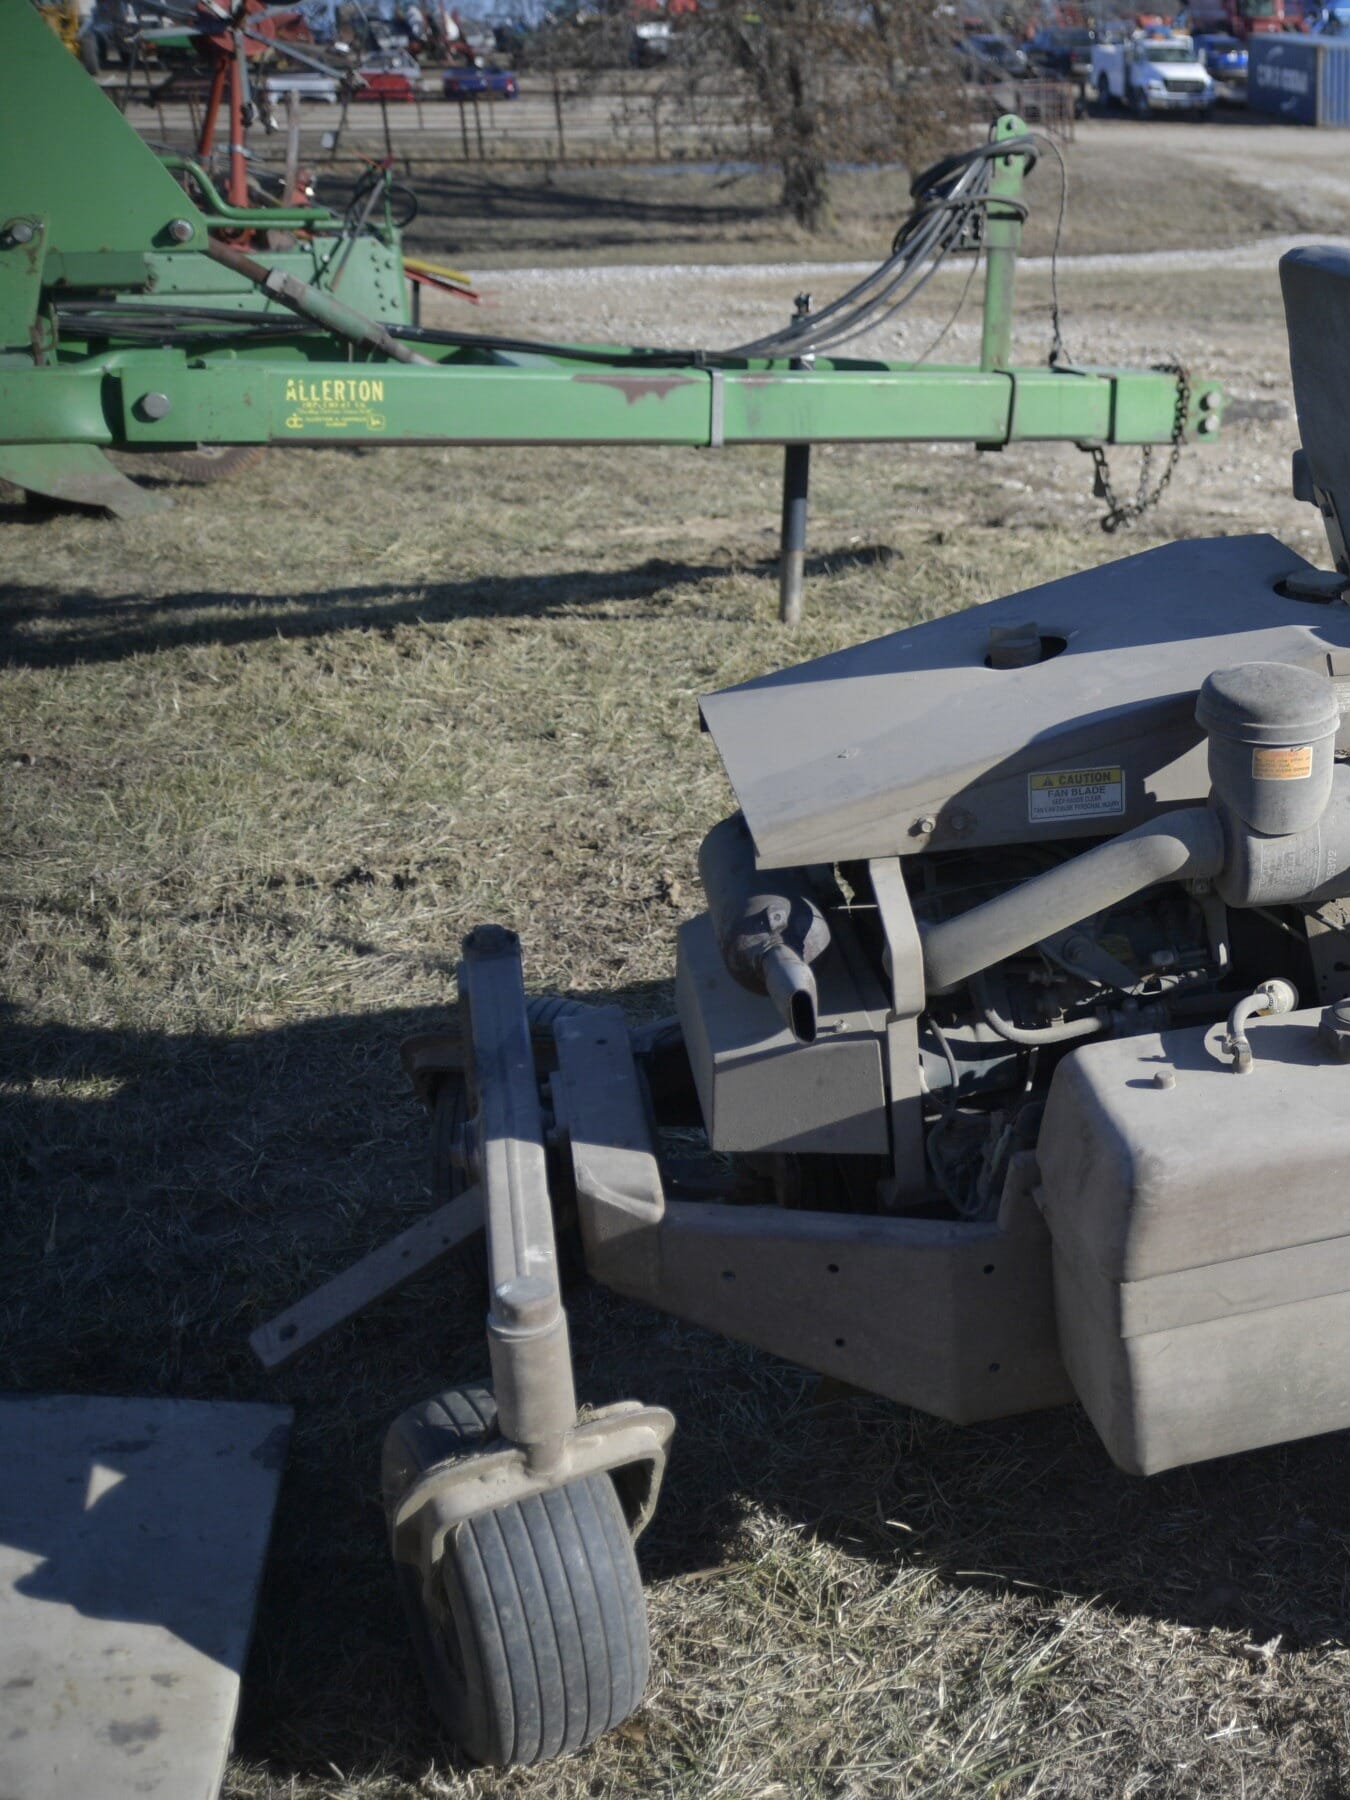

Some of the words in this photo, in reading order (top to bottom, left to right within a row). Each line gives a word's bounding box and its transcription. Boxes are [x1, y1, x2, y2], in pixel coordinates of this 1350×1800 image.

[285, 379, 384, 402] ALLERTON
[1059, 771, 1111, 785] CAUTION
[1047, 788, 1069, 798] FAN
[1071, 785, 1107, 796] BLADE
